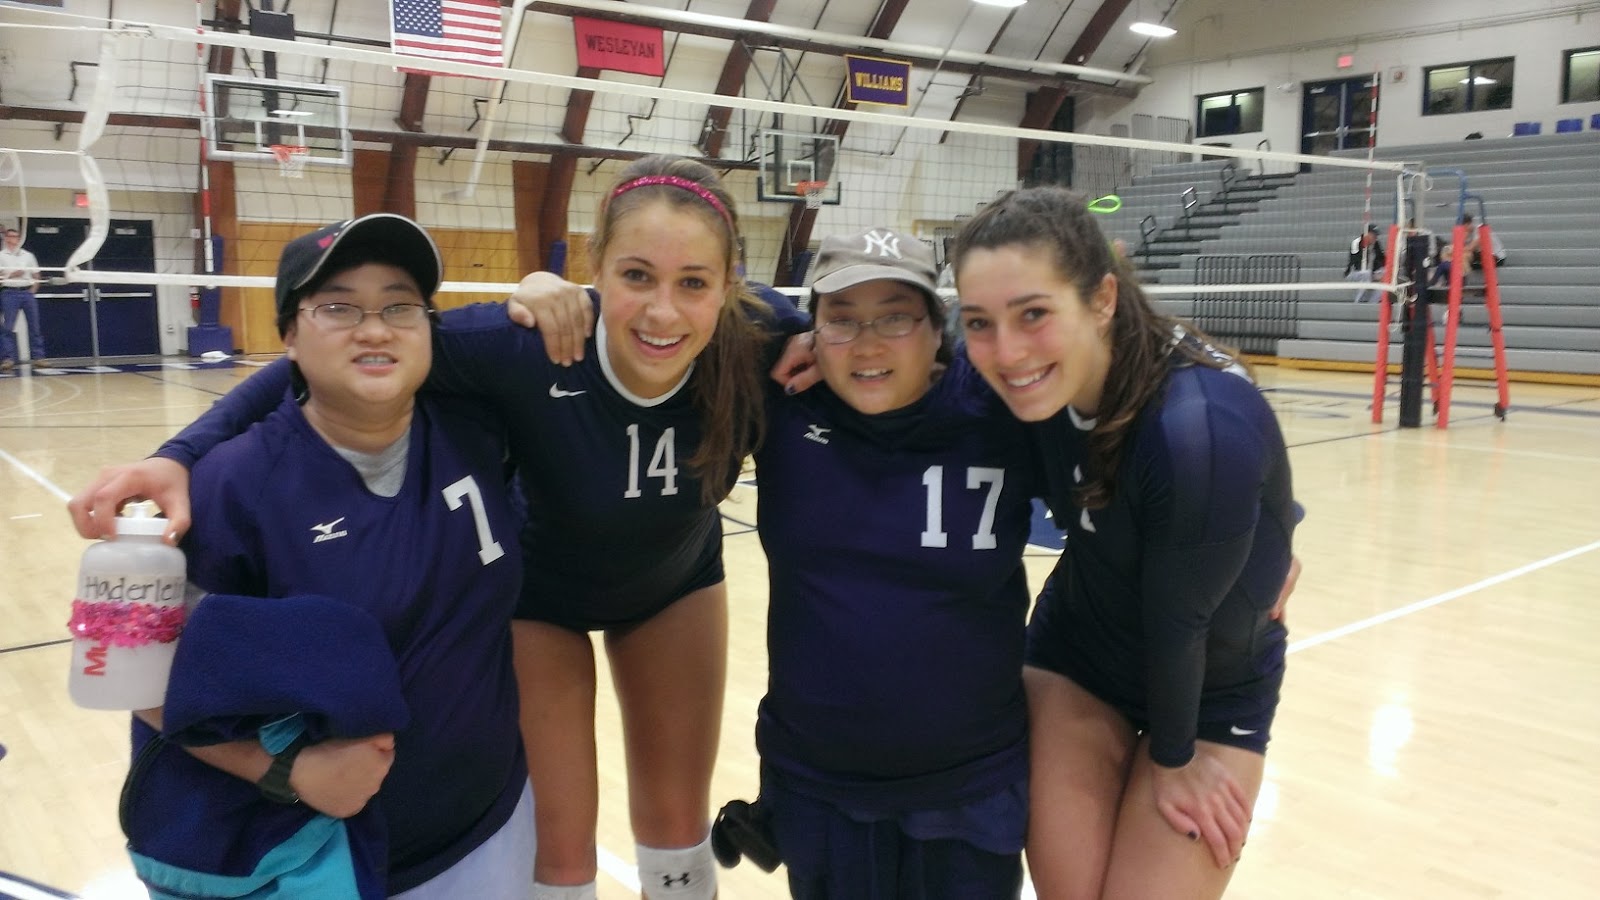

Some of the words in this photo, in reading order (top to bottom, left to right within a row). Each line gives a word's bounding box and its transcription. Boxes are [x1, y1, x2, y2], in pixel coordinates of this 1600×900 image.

[585, 34, 656, 58] WESLEYAN
[855, 72, 903, 91] WILLIAMS
[863, 230, 902, 260] NY
[624, 423, 679, 498] 14
[441, 474, 506, 566] 7
[921, 465, 1005, 550] 17
